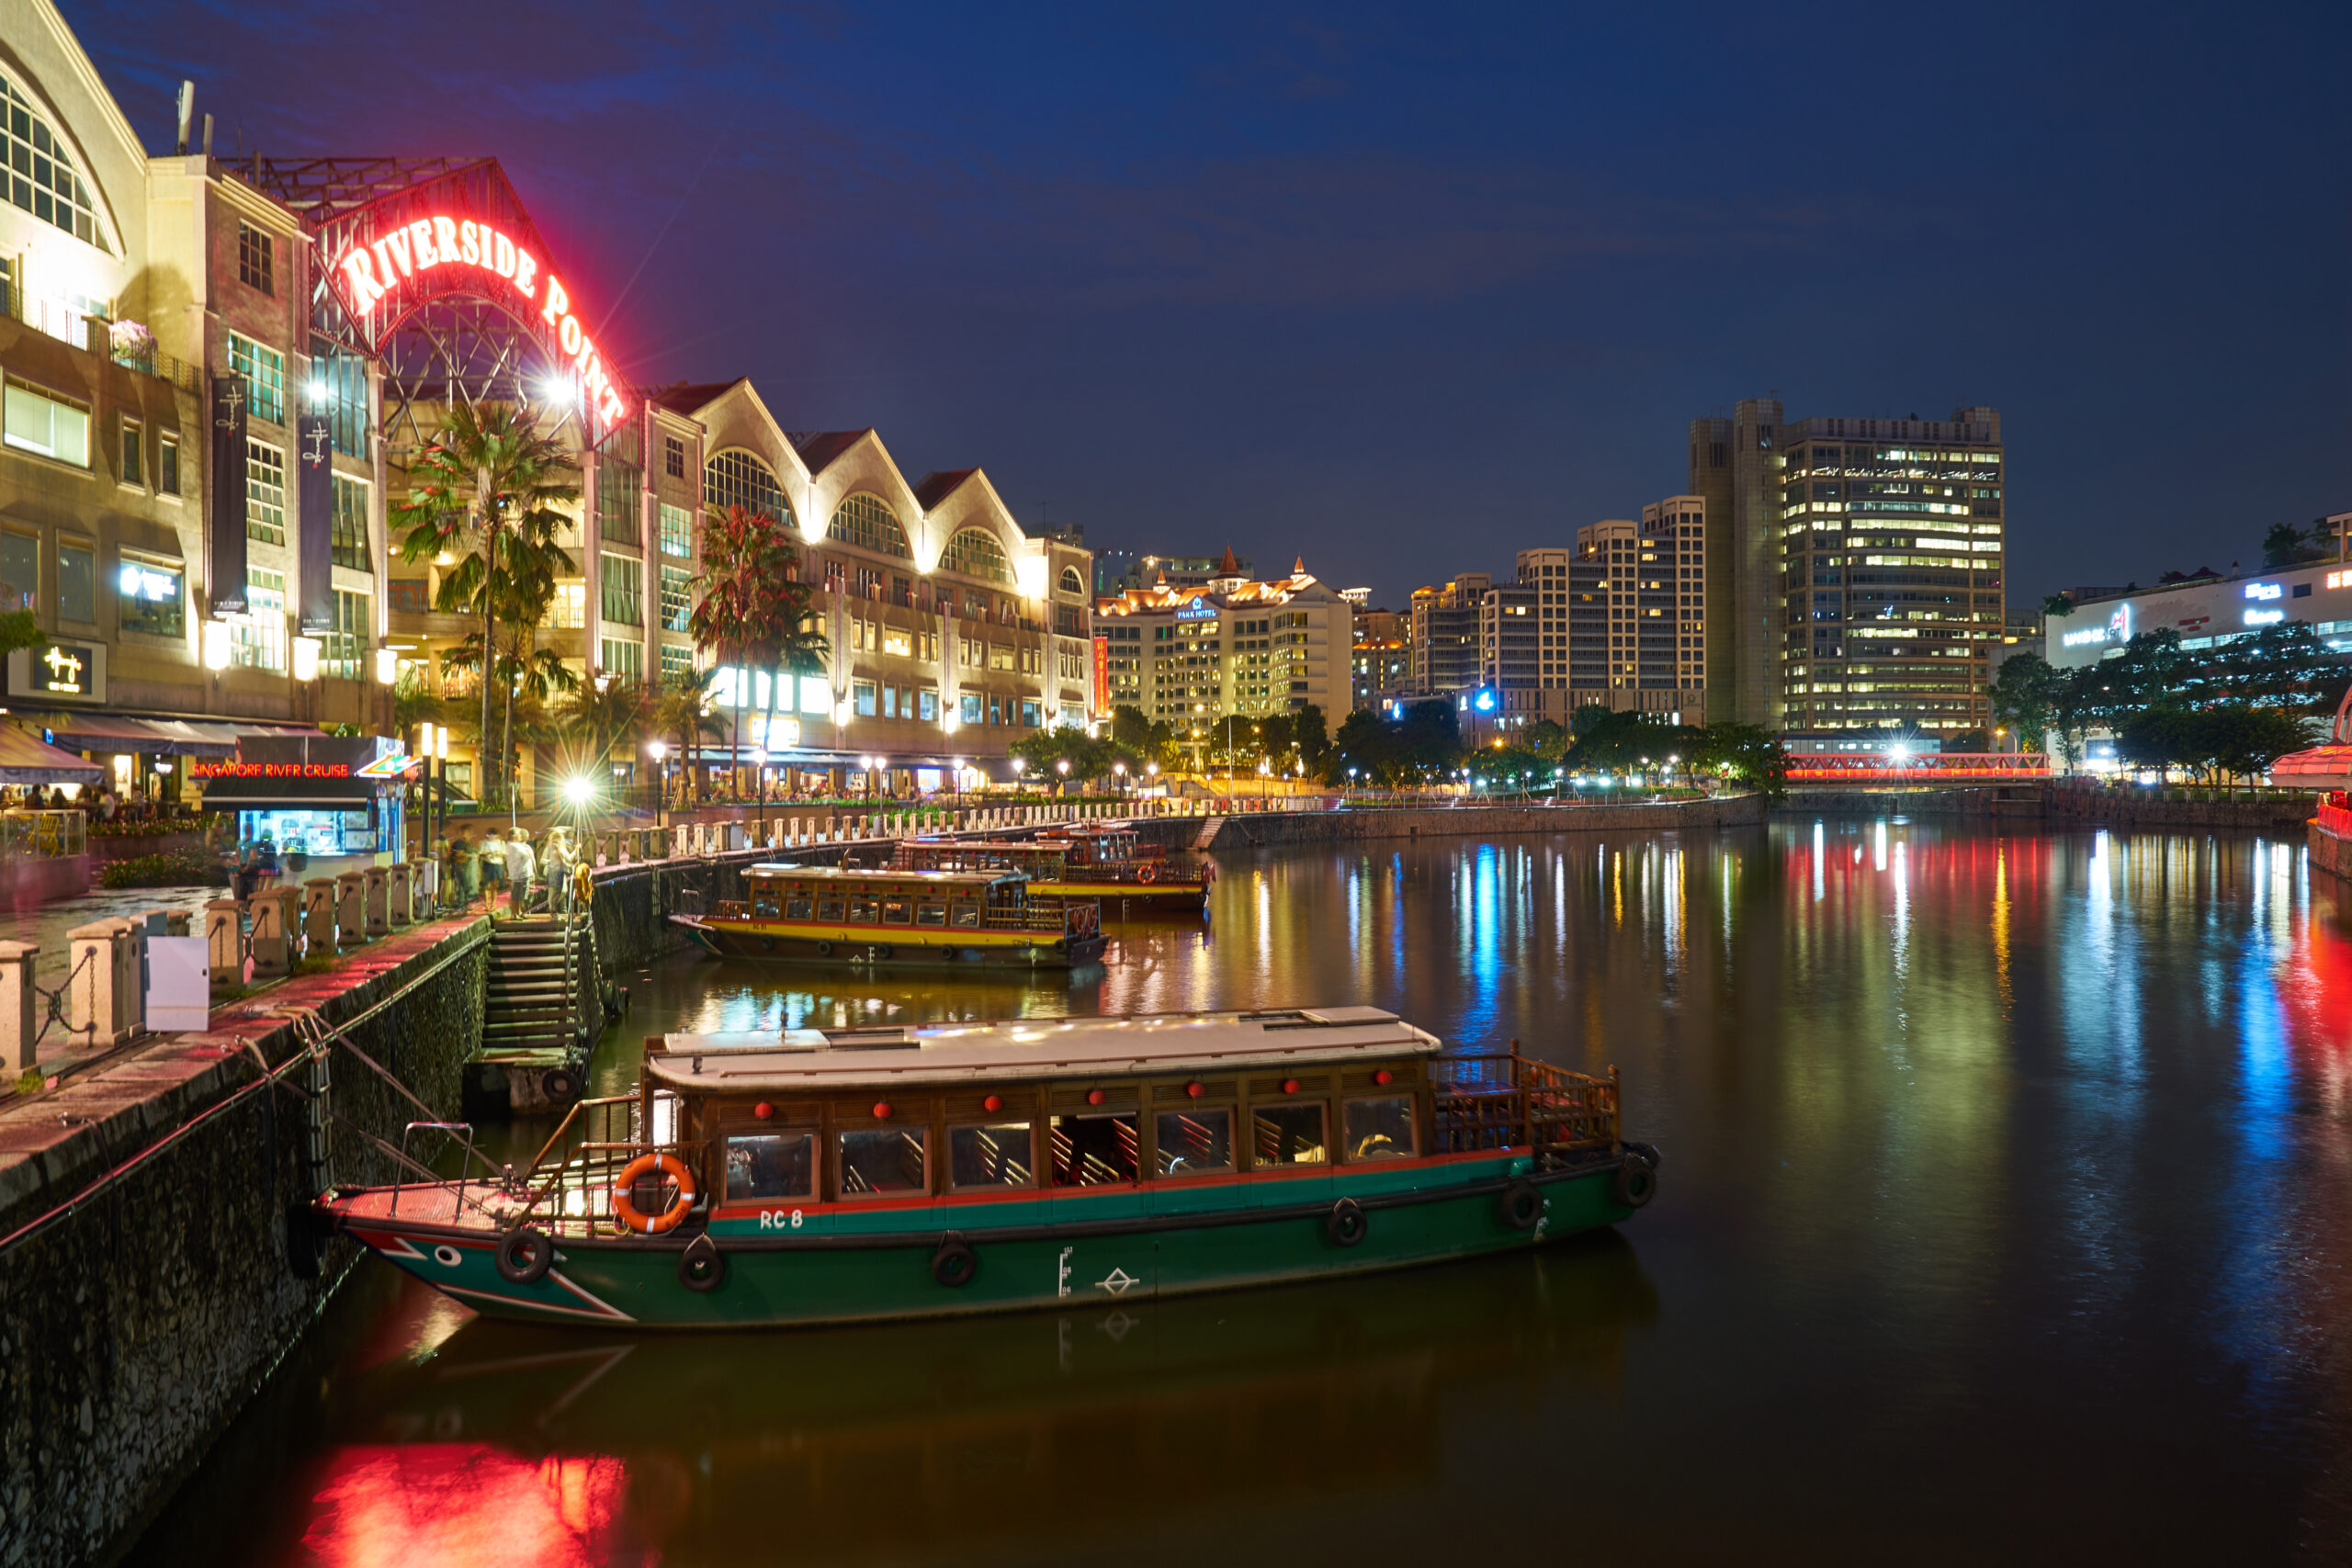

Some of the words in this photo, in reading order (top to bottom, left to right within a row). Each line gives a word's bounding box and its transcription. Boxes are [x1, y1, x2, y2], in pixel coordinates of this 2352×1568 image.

[341, 216, 537, 316] RIVERSIDE
[541, 274, 624, 426] POINT
[1195, 608, 1216, 618] HOTEL
[192, 763, 263, 778] SINGAPORE
[266, 763, 301, 778] RIVER
[304, 763, 349, 778] CRUISE
[760, 1211, 786, 1230] RC
[790, 1209, 803, 1227] 8
